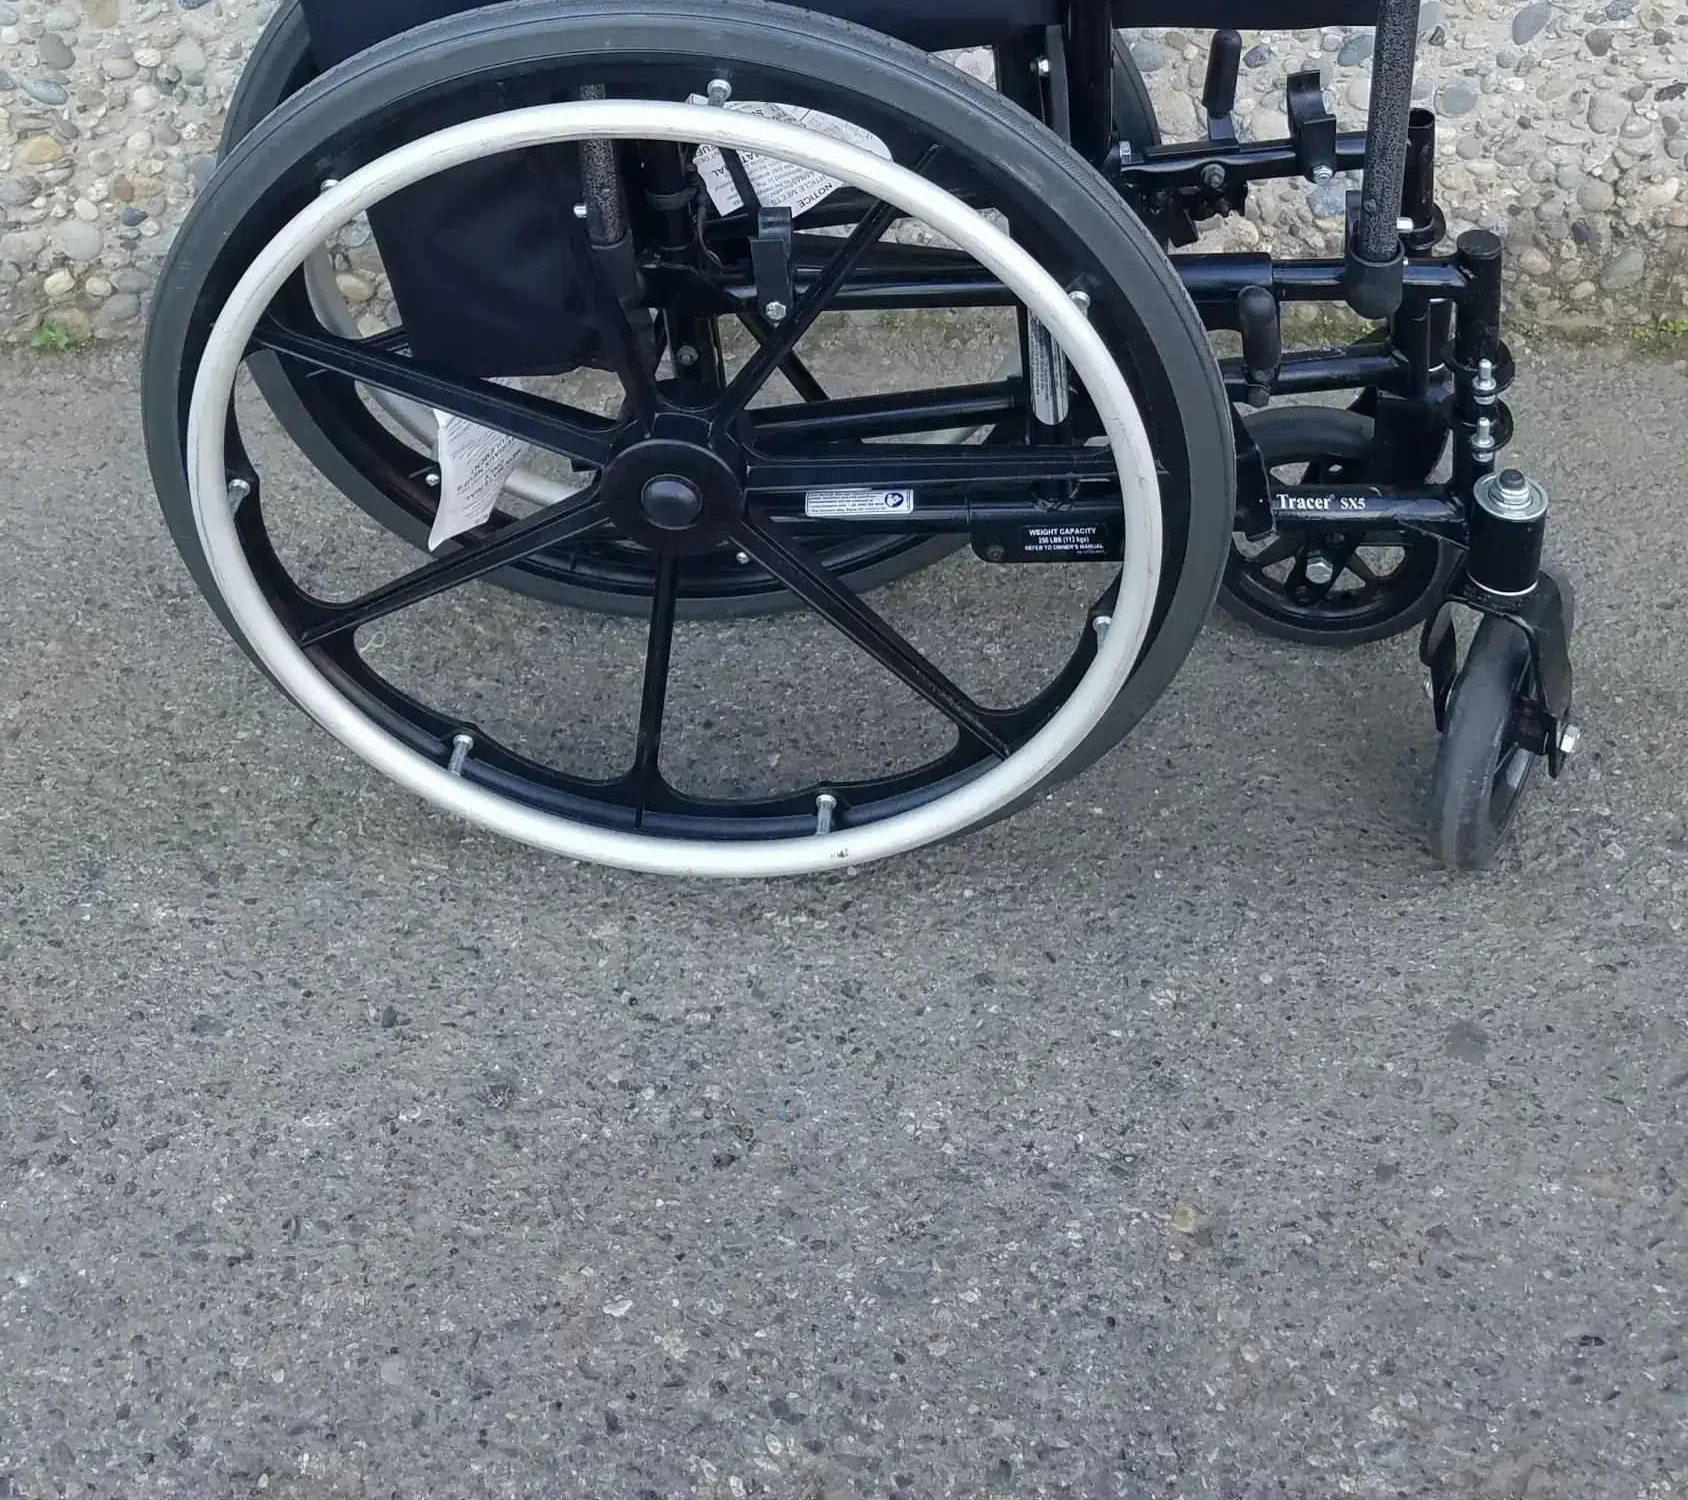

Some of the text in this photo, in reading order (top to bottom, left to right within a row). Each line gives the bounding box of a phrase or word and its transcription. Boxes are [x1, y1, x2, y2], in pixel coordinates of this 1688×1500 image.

[796, 182, 834, 209] NOTICE
[1340, 497, 1366, 510] SX5
[1029, 527, 1096, 536] WEIGHT CAPACITY
